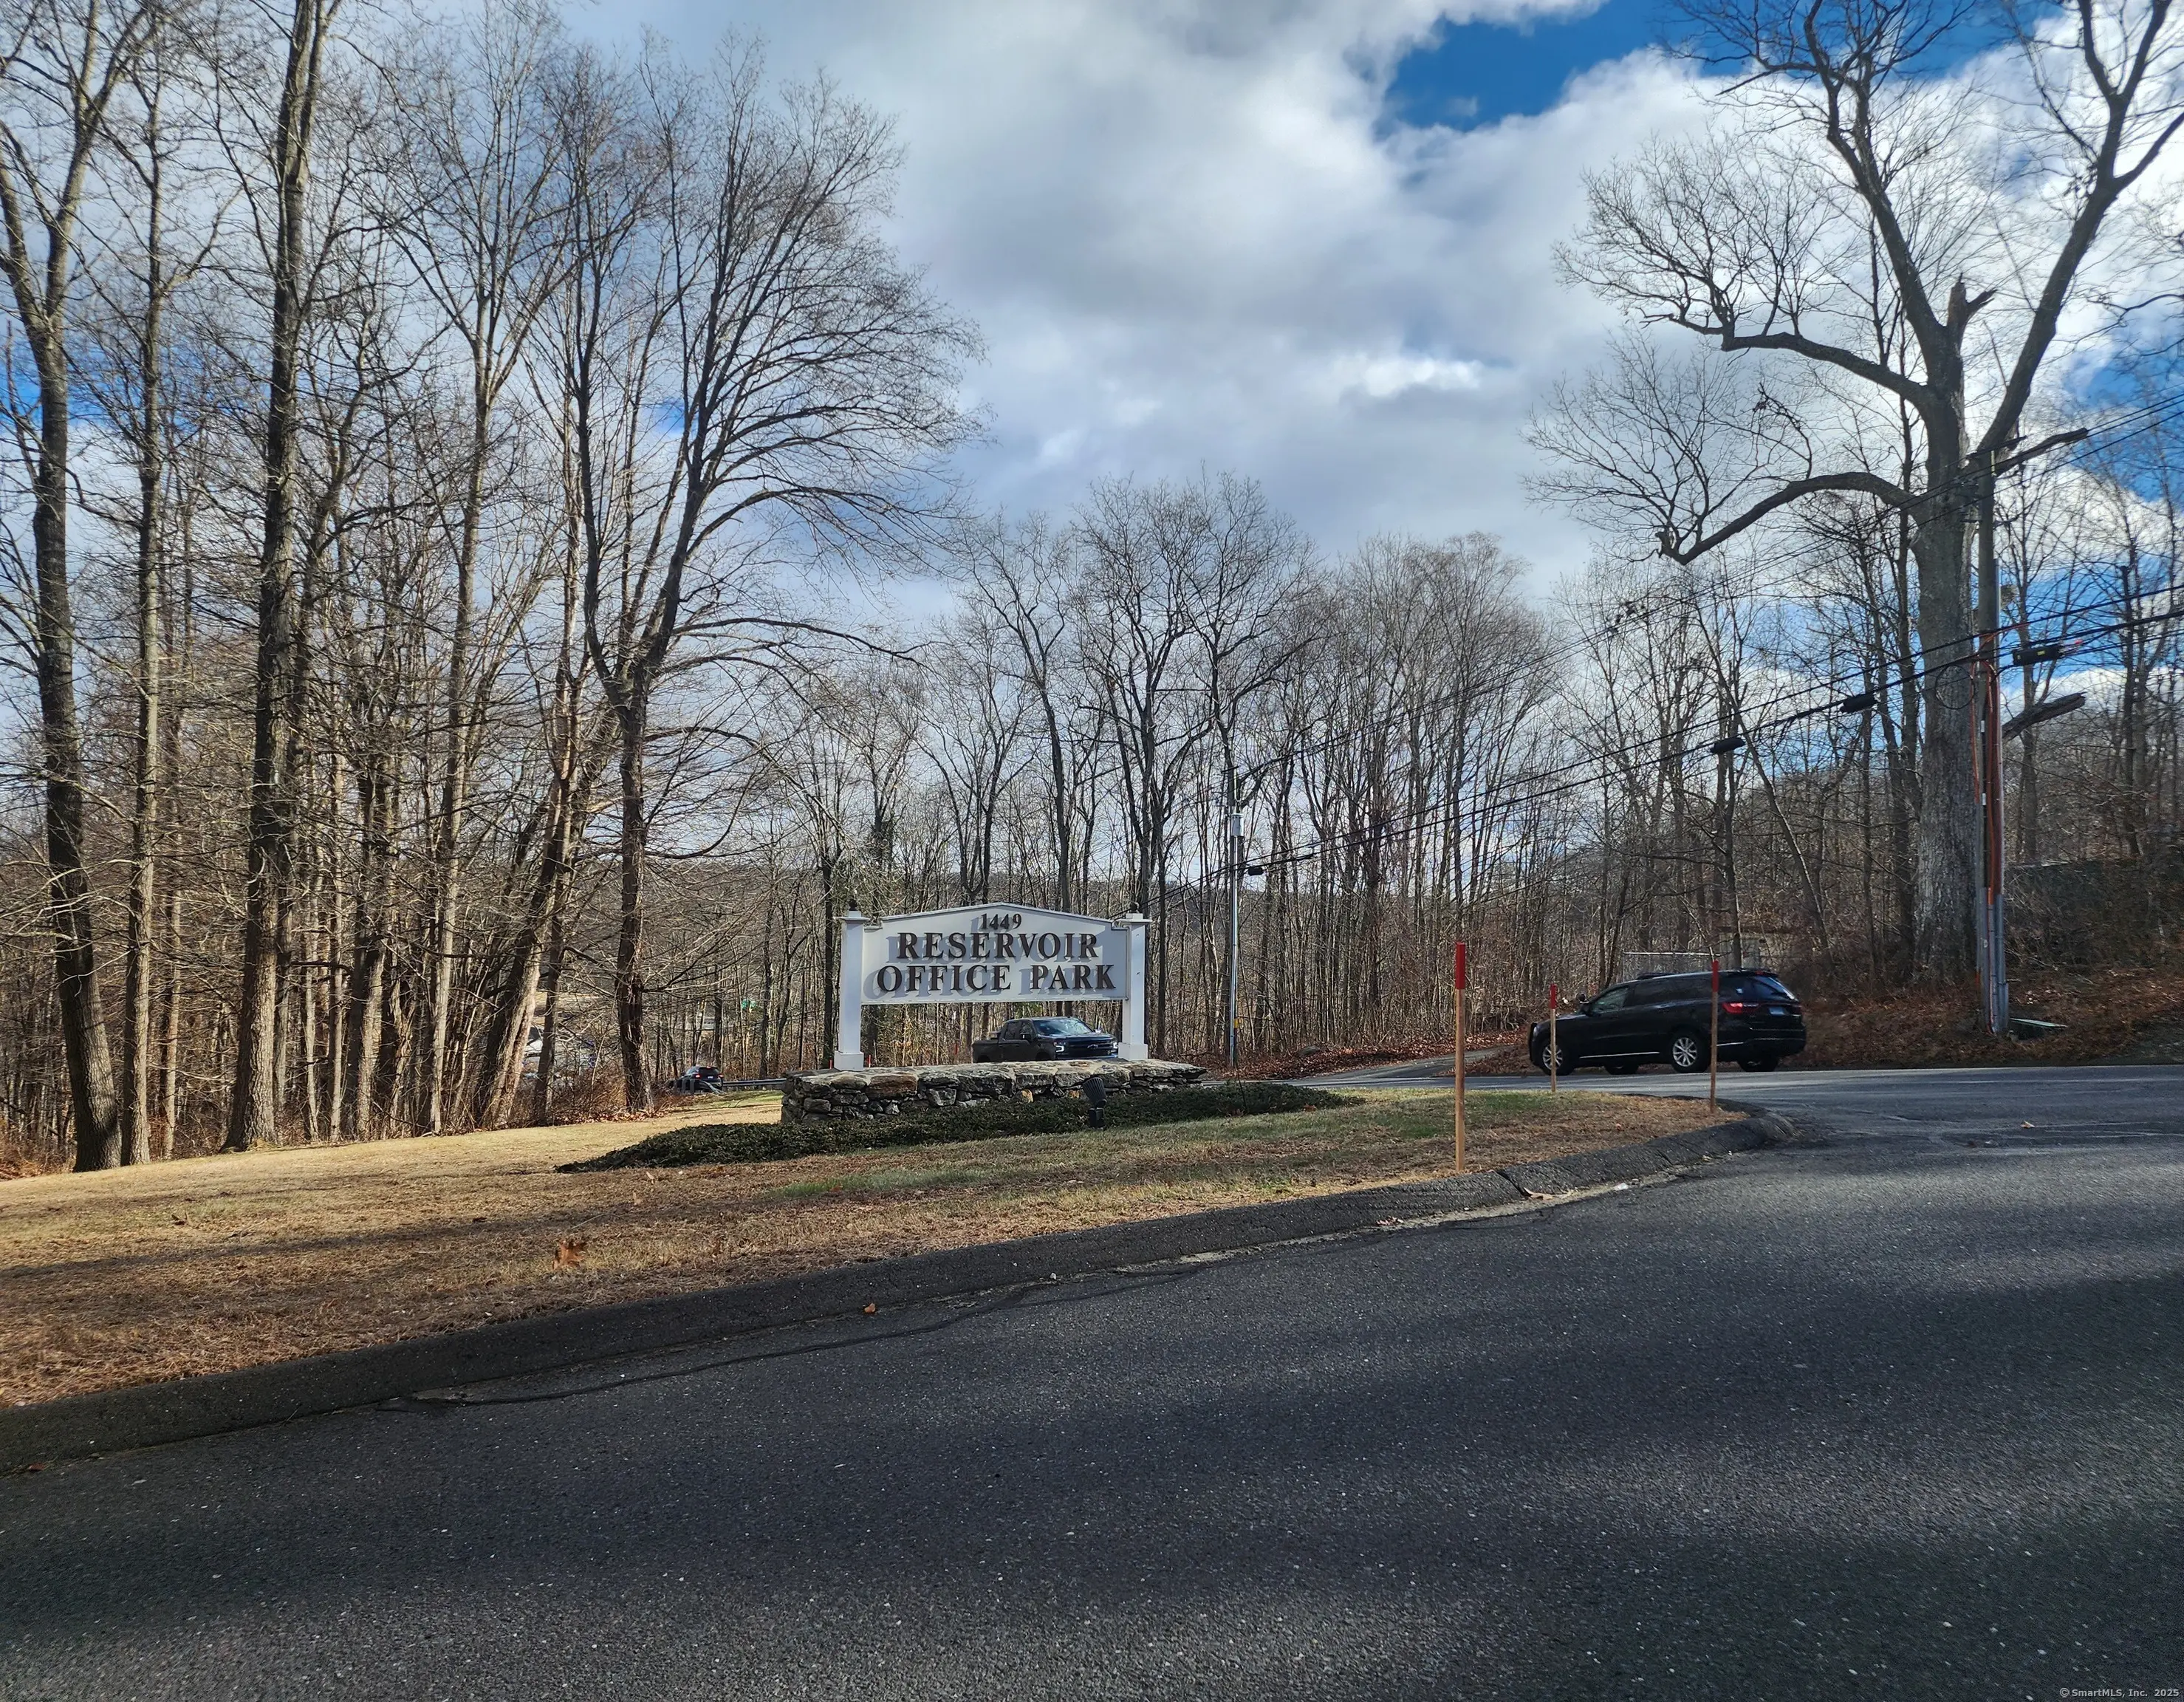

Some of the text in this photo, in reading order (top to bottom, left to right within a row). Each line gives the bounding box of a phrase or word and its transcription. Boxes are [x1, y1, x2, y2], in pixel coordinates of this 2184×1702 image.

[981, 913, 1022, 931] 1449
[897, 932, 1099, 960] RESERVOIR
[877, 963, 1116, 992] OFFICE PARK
